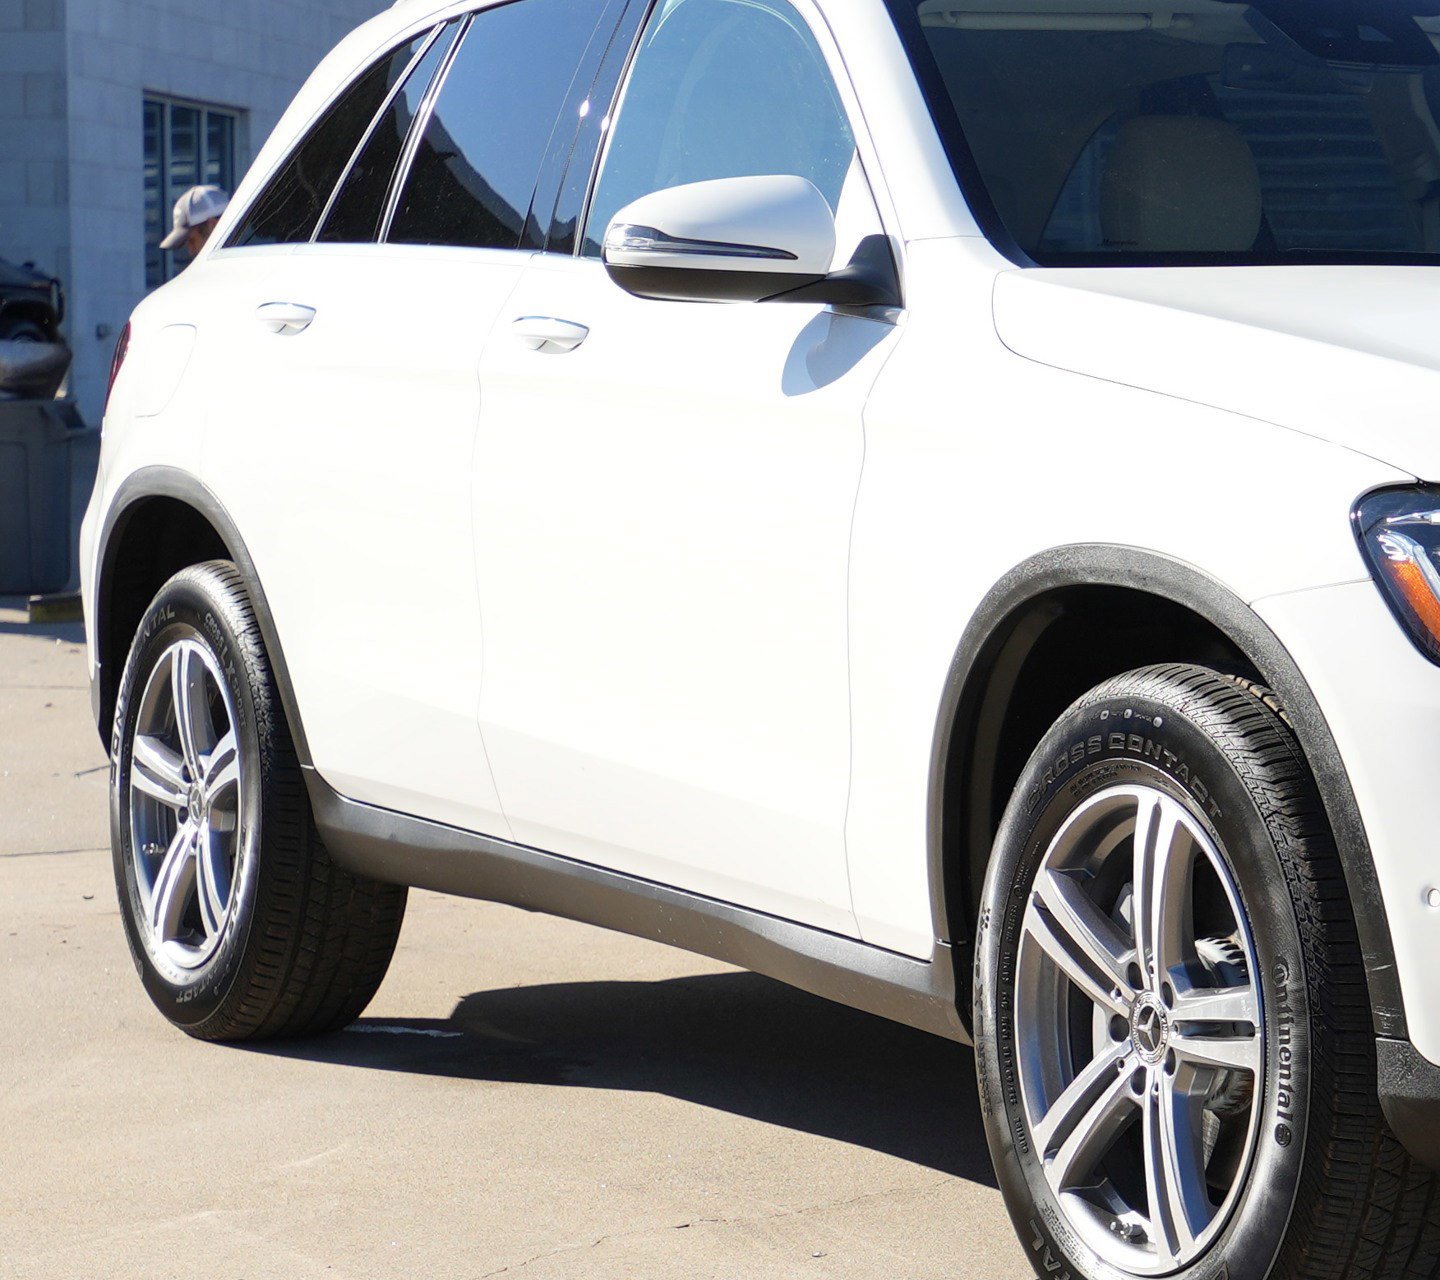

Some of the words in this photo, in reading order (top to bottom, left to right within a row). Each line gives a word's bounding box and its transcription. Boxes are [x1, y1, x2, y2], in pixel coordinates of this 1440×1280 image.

[1026, 734, 1102, 813] CROSS
[1107, 732, 1224, 819] CONTACT
[1272, 956, 1294, 1122] Continental
